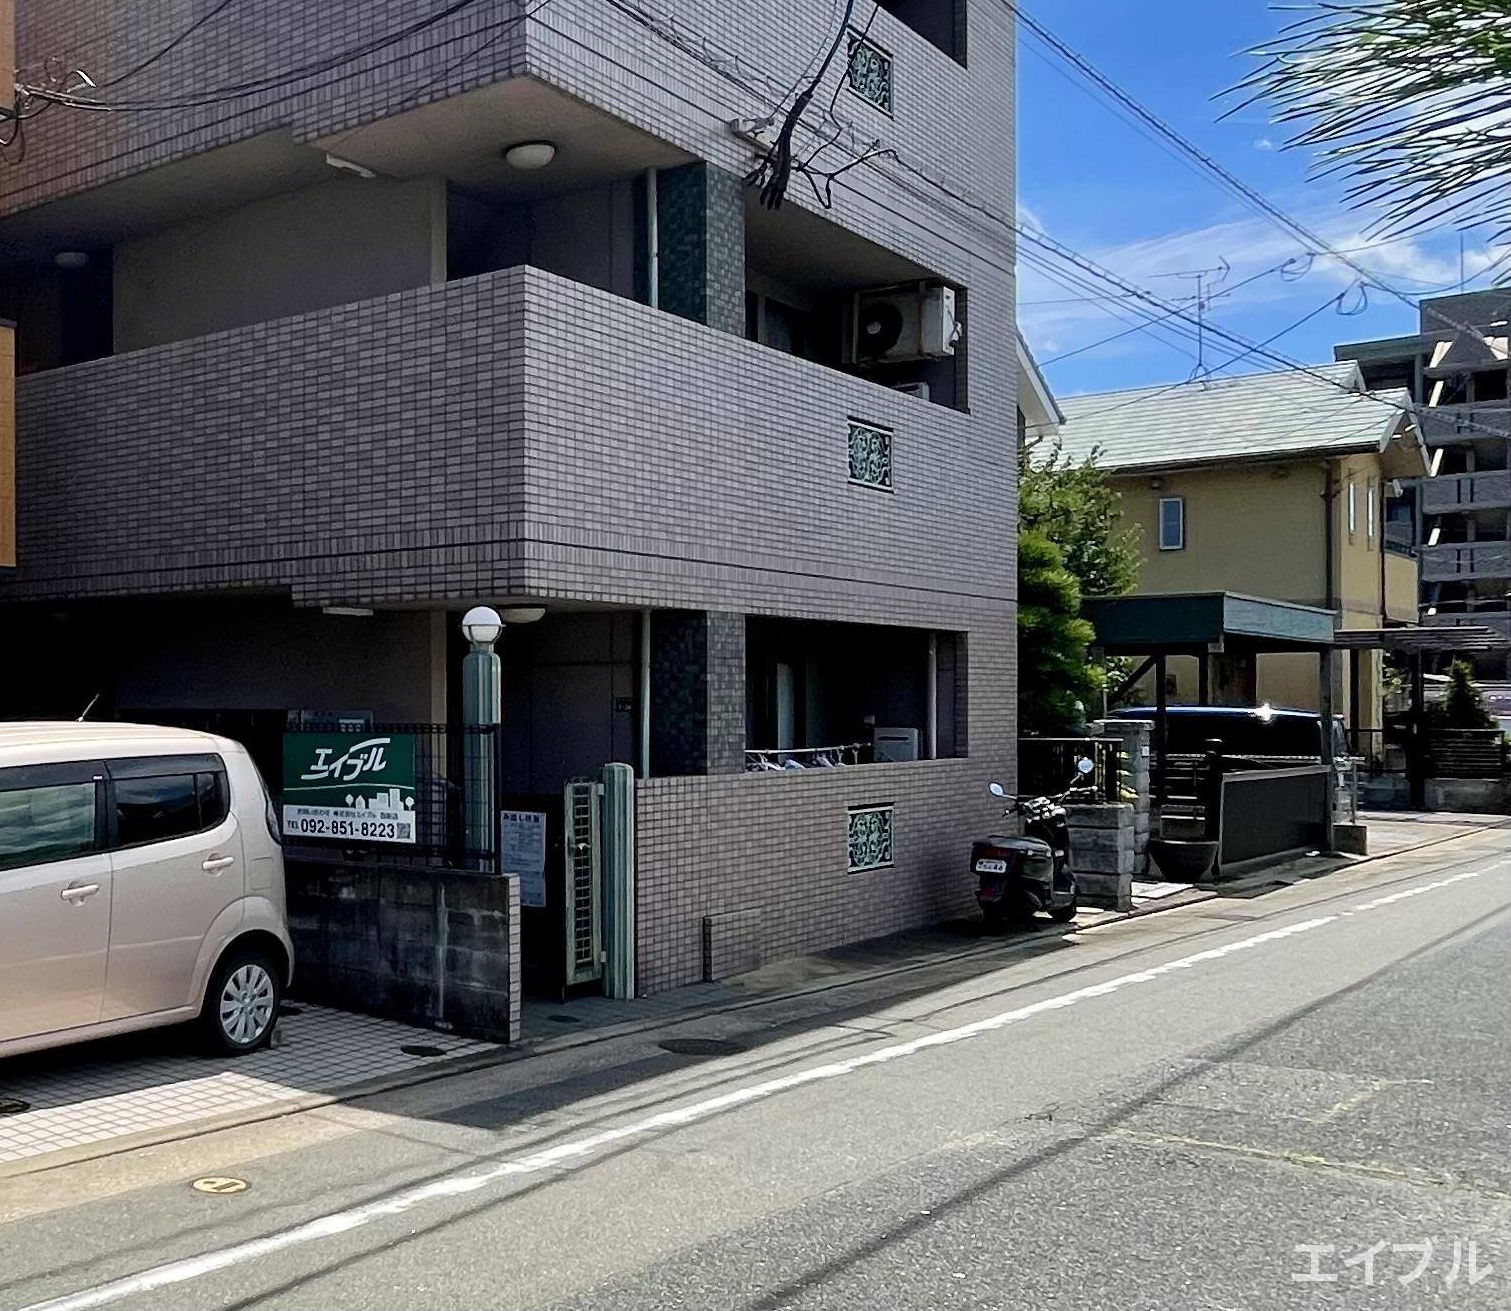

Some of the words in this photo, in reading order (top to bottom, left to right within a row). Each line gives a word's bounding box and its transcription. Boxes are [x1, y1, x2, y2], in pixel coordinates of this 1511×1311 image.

[300, 737, 391, 781] エイブル
[300, 818, 395, 839] 092-851-8223
